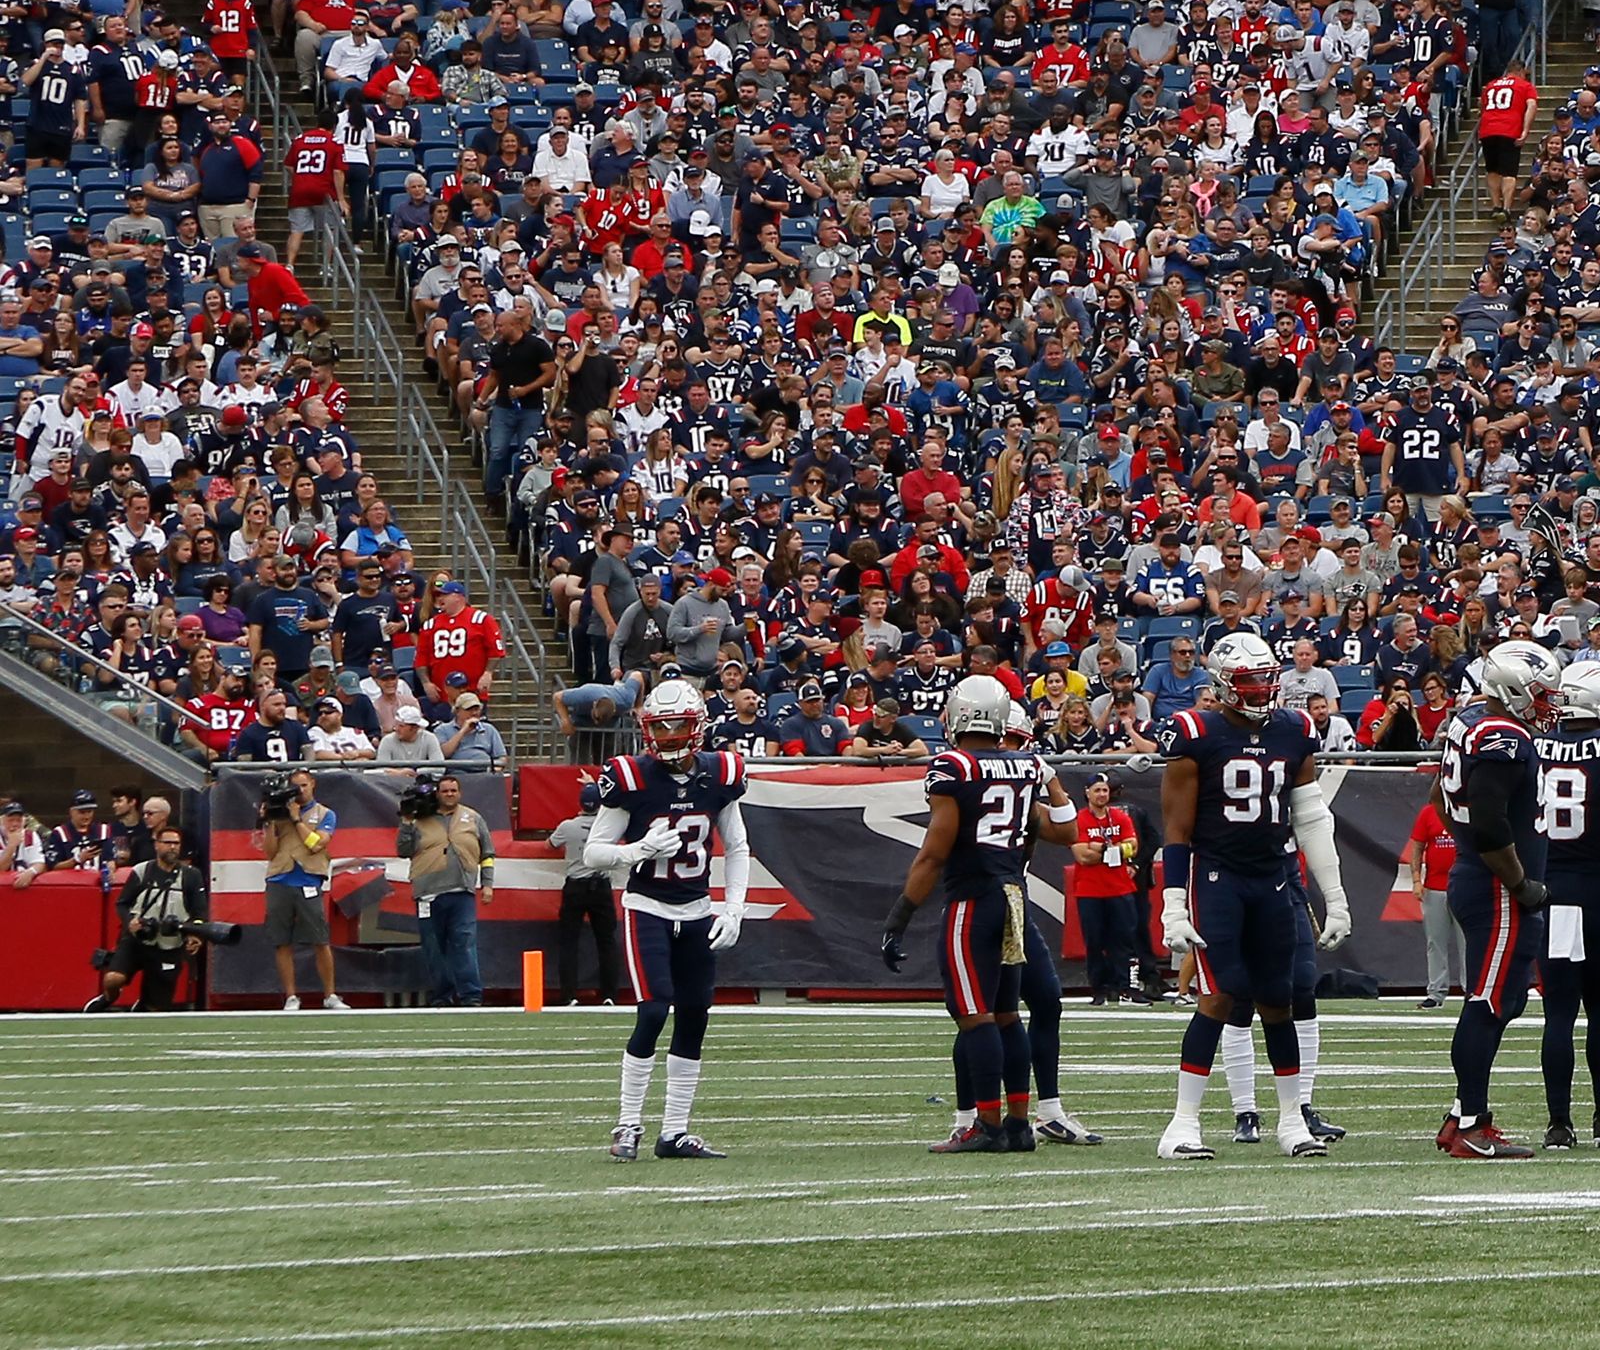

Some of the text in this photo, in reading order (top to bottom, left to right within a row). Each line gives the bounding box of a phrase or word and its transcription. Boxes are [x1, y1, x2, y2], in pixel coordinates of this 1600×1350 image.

[218, 11, 239, 32] 12
[1414, 36, 1431, 61] 10
[120, 55, 143, 80] 10
[42, 76, 67, 103] 10
[146, 84, 169, 107] 10
[1486, 88, 1512, 109] 10
[342, 125, 362, 145] 10
[297, 150, 325, 173] 23
[1254, 154, 1276, 175] 10
[174, 250, 206, 277] 33
[1483, 302, 1508, 311] SALTY
[708, 377, 736, 405] 87
[1403, 430, 1439, 459] 22
[434, 628, 466, 657] 69
[1344, 642, 1360, 665] 9
[910, 689, 948, 714] 97
[211, 709, 244, 729] 87
[973, 710, 992, 721] 21
[265, 739, 287, 765] 9
[978, 758, 1037, 781] PHILLIPS
[1223, 760, 1285, 823] 91
[977, 785, 1033, 847] 21
